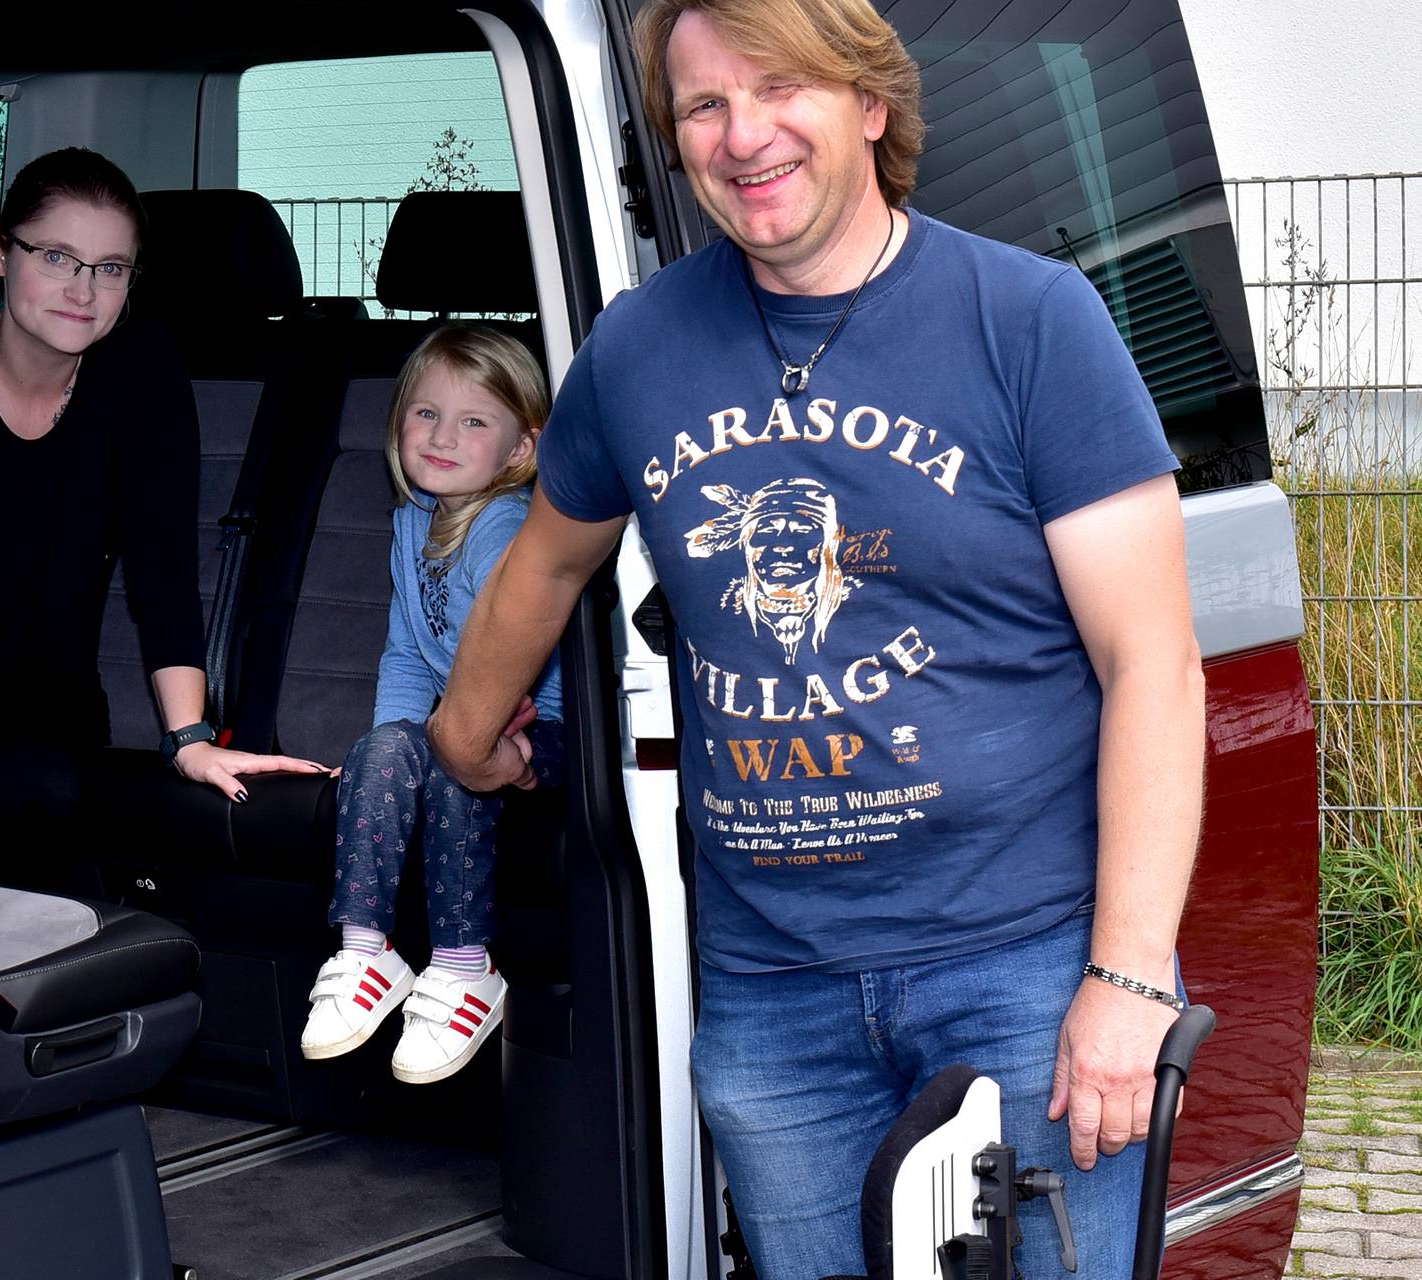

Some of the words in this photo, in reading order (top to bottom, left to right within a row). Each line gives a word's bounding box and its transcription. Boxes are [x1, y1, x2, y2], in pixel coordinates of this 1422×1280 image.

[642, 398, 966, 502] SARASOTA
[686, 626, 936, 722] VILLAGE
[727, 733, 864, 782] WAP
[800, 795, 838, 814] TRUE
[845, 781, 942, 810] WILDERNESS
[753, 856, 781, 867] FIND
[785, 855, 821, 866] YOUR
[823, 851, 866, 864] TRAIL
